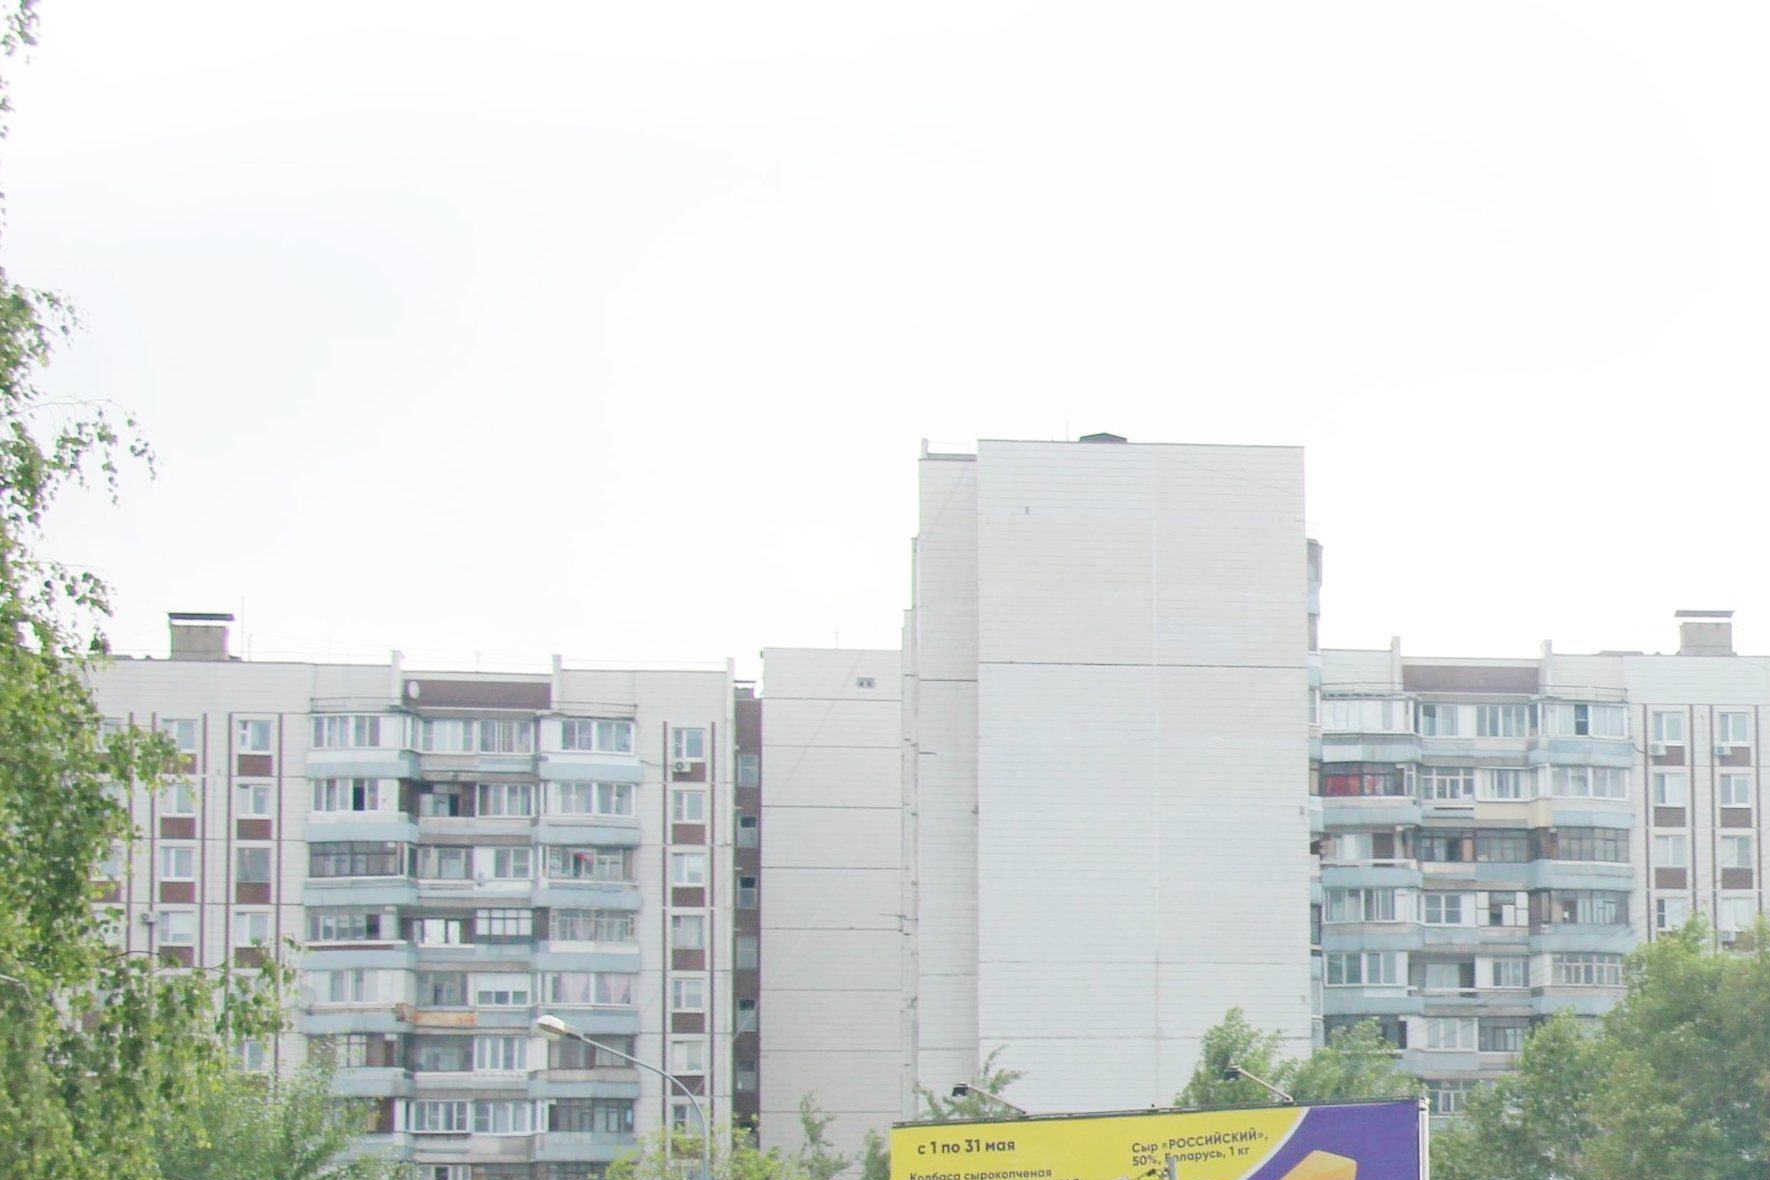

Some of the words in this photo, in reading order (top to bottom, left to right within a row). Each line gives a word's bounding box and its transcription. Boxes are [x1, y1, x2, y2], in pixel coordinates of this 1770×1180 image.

[917, 1144, 926, 1155] с
[930, 1141, 937, 1154] 1
[941, 1142, 961, 1154] по
[965, 1139, 981, 1153] 31
[985, 1140, 1016, 1152] мая
[1132, 1142, 1159, 1154] Сыр
[1162, 1128, 1268, 1150] «РОССИЙСКИЙ»,
[1132, 1154, 1162, 1167] 50%,
[1164, 1149, 1226, 1164] Бларусь,
[1229, 1146, 1235, 1156] 1
[1237, 1146, 1251, 1157] кг
